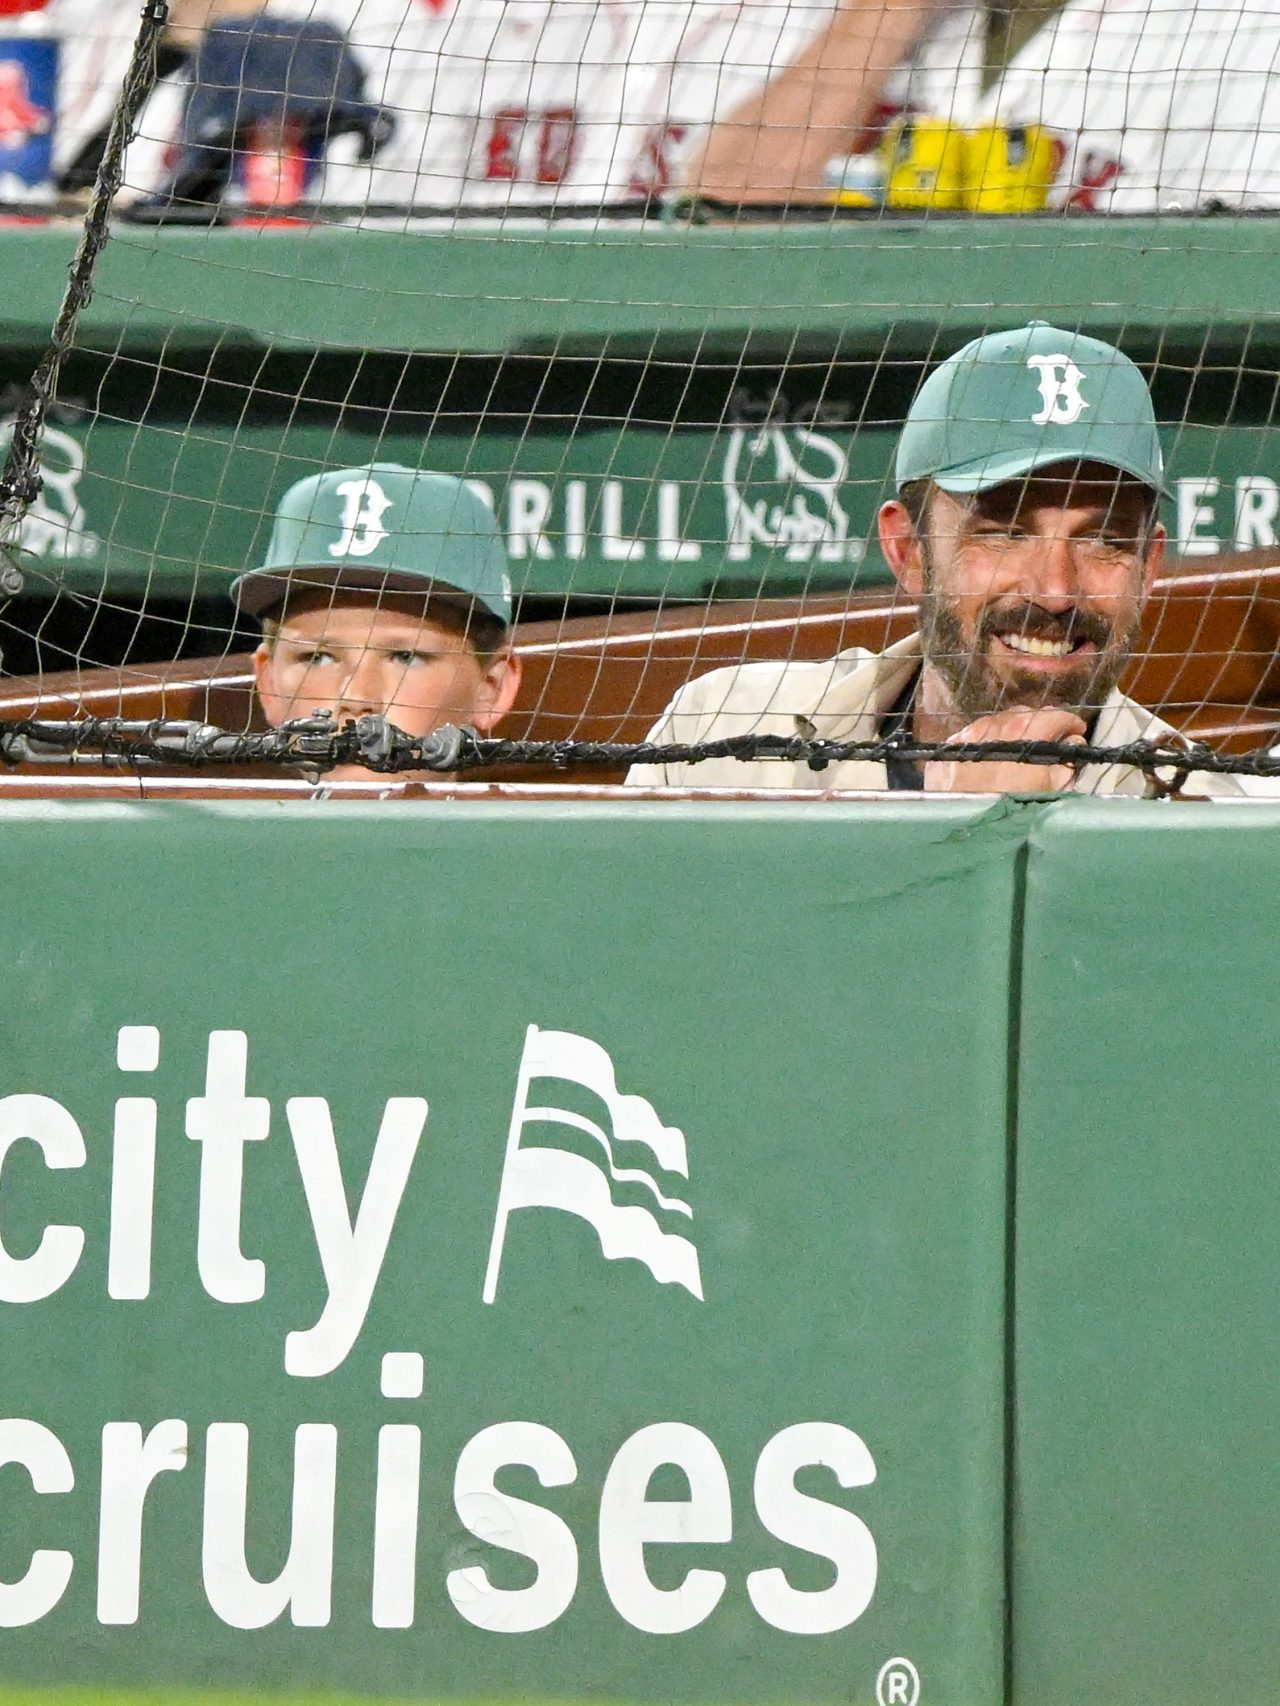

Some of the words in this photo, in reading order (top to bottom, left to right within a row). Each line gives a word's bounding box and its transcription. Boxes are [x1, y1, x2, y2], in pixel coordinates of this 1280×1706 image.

[1026, 354, 1090, 425] B
[328, 480, 394, 556] B
[463, 479, 701, 562] RILL
[0, 1025, 428, 1377] city
[0, 1351, 877, 1634] cruises
